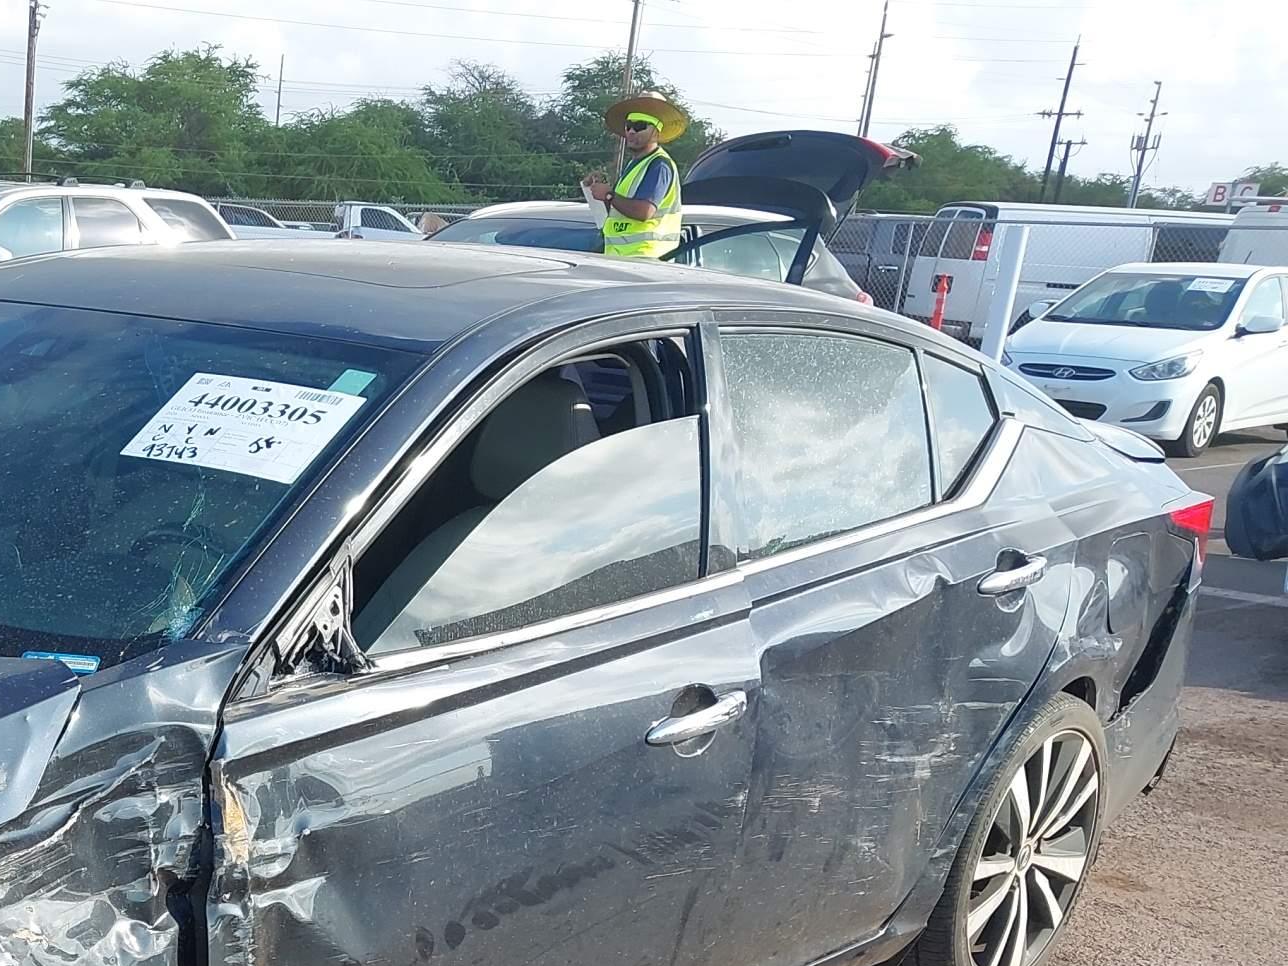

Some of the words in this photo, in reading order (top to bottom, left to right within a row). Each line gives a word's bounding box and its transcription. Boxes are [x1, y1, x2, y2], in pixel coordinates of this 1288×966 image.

[1212, 185, 1227, 203] B
[613, 222, 631, 232] CAT
[188, 392, 328, 425] 44003305
